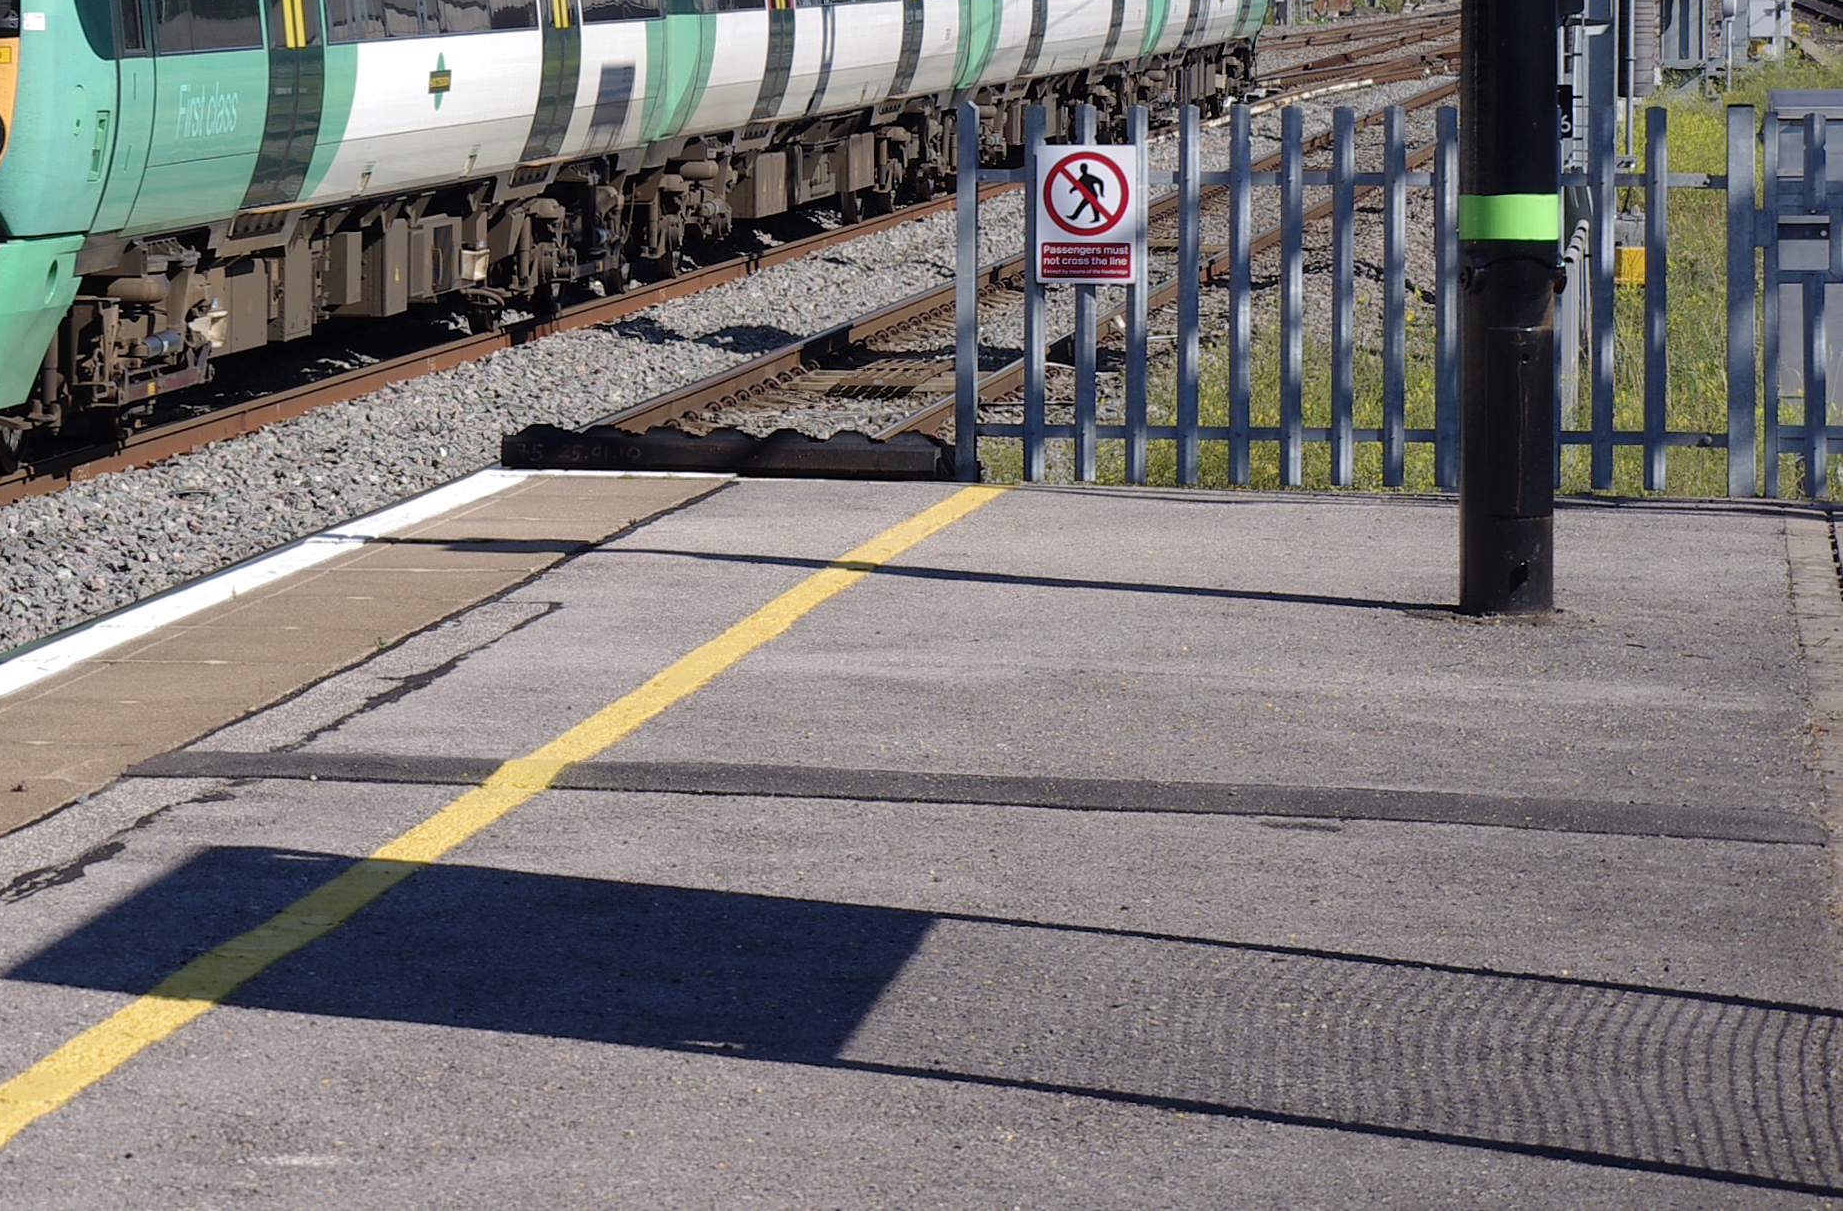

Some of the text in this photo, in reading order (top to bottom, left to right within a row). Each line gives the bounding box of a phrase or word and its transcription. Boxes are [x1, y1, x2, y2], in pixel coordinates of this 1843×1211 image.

[176, 81, 239, 139] First class
[1043, 245, 1129, 256] Passengers must
[1043, 256, 1128, 266] not cross the line
